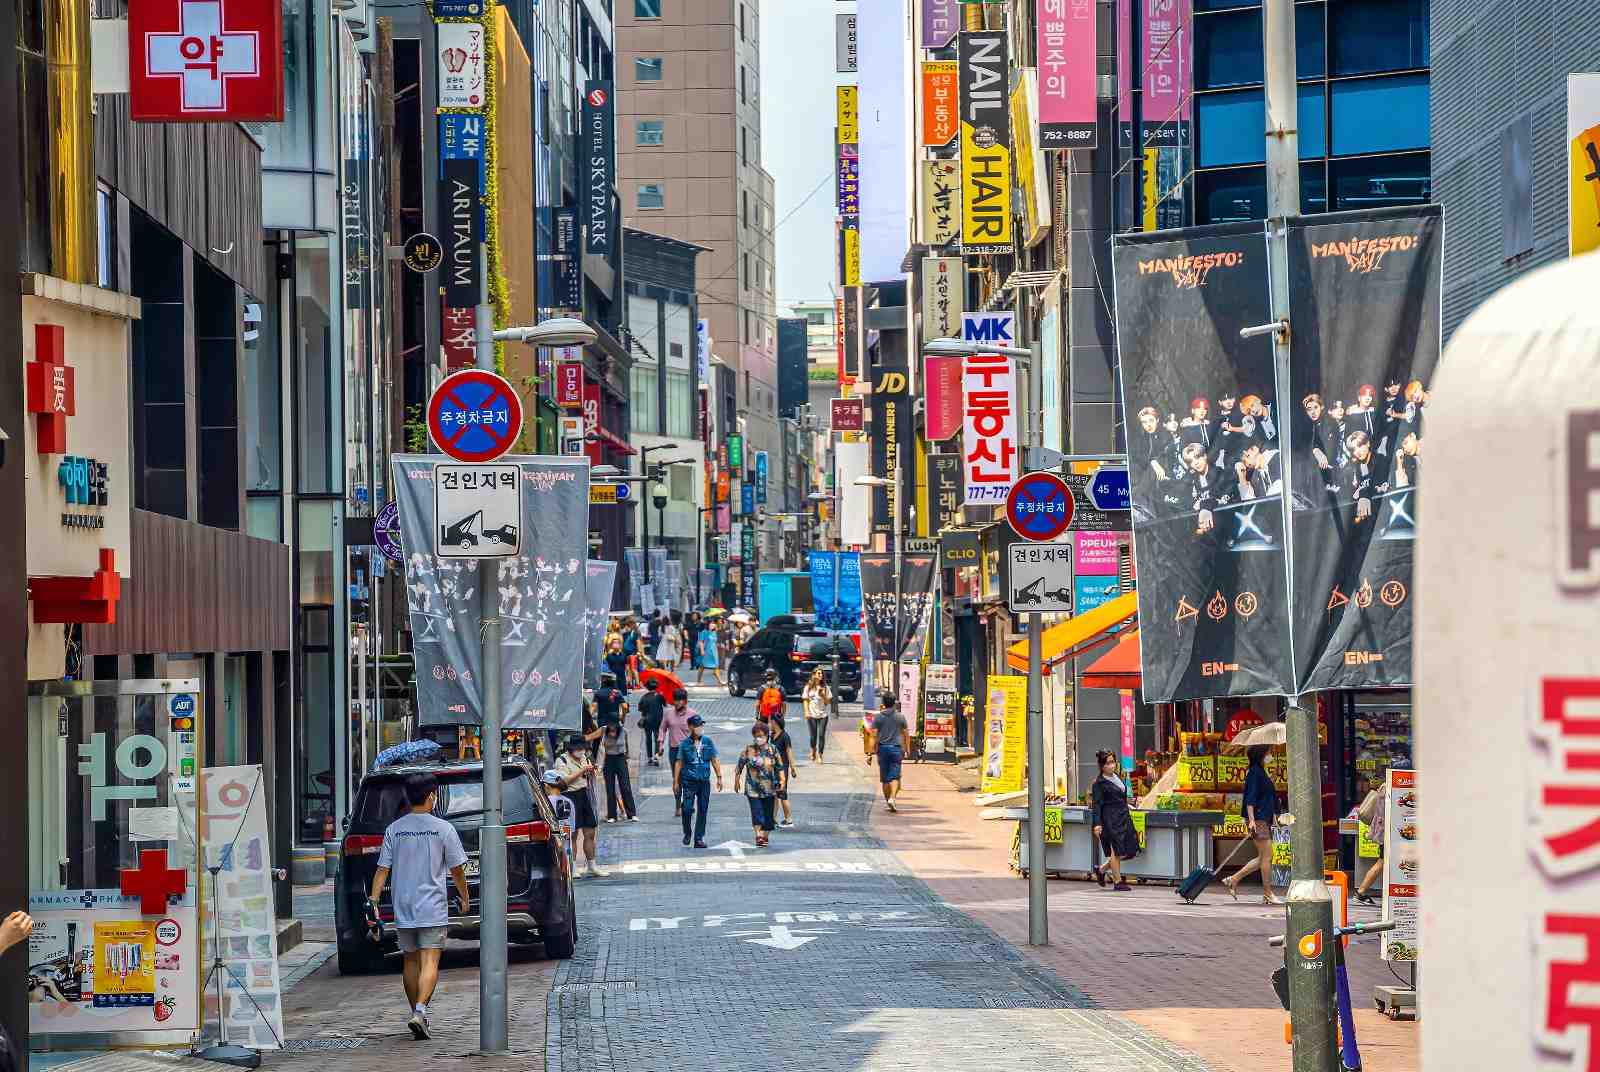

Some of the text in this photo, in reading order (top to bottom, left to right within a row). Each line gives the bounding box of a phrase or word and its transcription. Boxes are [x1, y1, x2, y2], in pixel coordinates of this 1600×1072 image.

[180, 35, 224, 81] 약
[468, 30, 481, 90] マッサージ
[1044, 0, 1066, 98] 예쁨주의
[968, 38, 1002, 121] NAIL
[933, 88, 950, 140] 부동산
[462, 117, 479, 157] 사주
[1044, 130, 1092, 141] 752-8887
[592, 113, 606, 245] HOTEL SKYPARK
[971, 155, 1004, 237] HAIR
[452, 180, 472, 286] ARITAUM
[1311, 234, 1418, 258] MANIFESTO:
[1138, 251, 1244, 276] MANIFESTO:
[965, 318, 1012, 341] MK
[53, 366, 67, 412] 愛
[876, 372, 906, 393] JD
[441, 409, 508, 425] 주정차금지
[965, 344, 1017, 483] 부동산
[886, 401, 896, 457] TRAINERS
[442, 471, 516, 490] 견인지역
[1097, 484, 1110, 494] 45
[1015, 501, 1066, 513] 주정차금지
[907, 541, 938, 551] LUSH
[946, 549, 976, 560] CLIO
[1015, 549, 1069, 563] 견인지역
[175, 701, 191, 710] ADT
